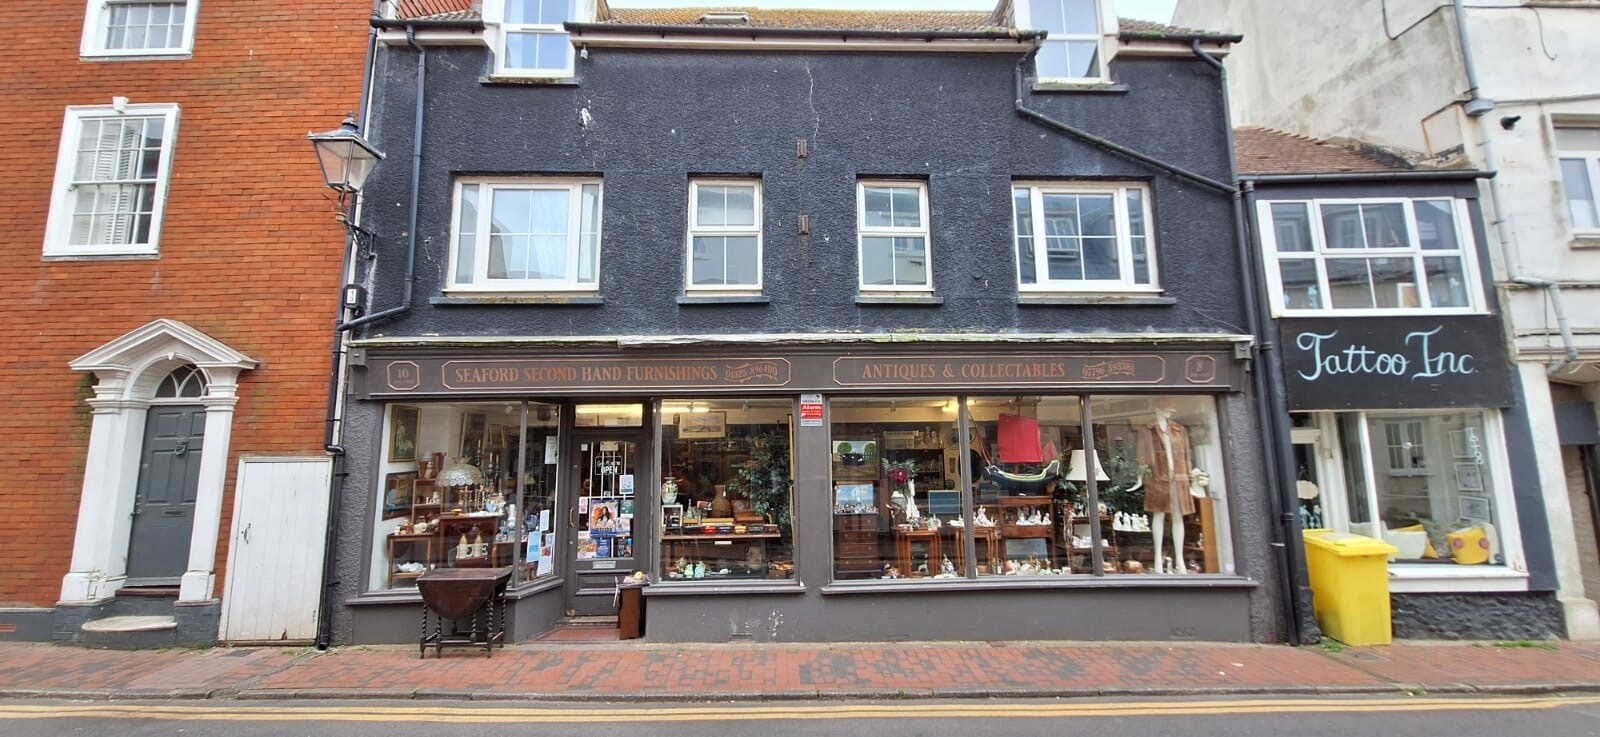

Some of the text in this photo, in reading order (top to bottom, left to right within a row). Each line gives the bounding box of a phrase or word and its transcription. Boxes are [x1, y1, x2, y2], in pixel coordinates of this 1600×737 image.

[1296, 329, 1411, 381] Tattoo
[862, 362, 1065, 380] ANTIQUES & COLLECTABLES
[1195, 360, 1203, 371] 8
[397, 368, 409, 379] 10
[455, 365, 718, 383] SEAFORD SECOND HAND FURNISHINGS
[601, 465, 618, 474] OPEN
